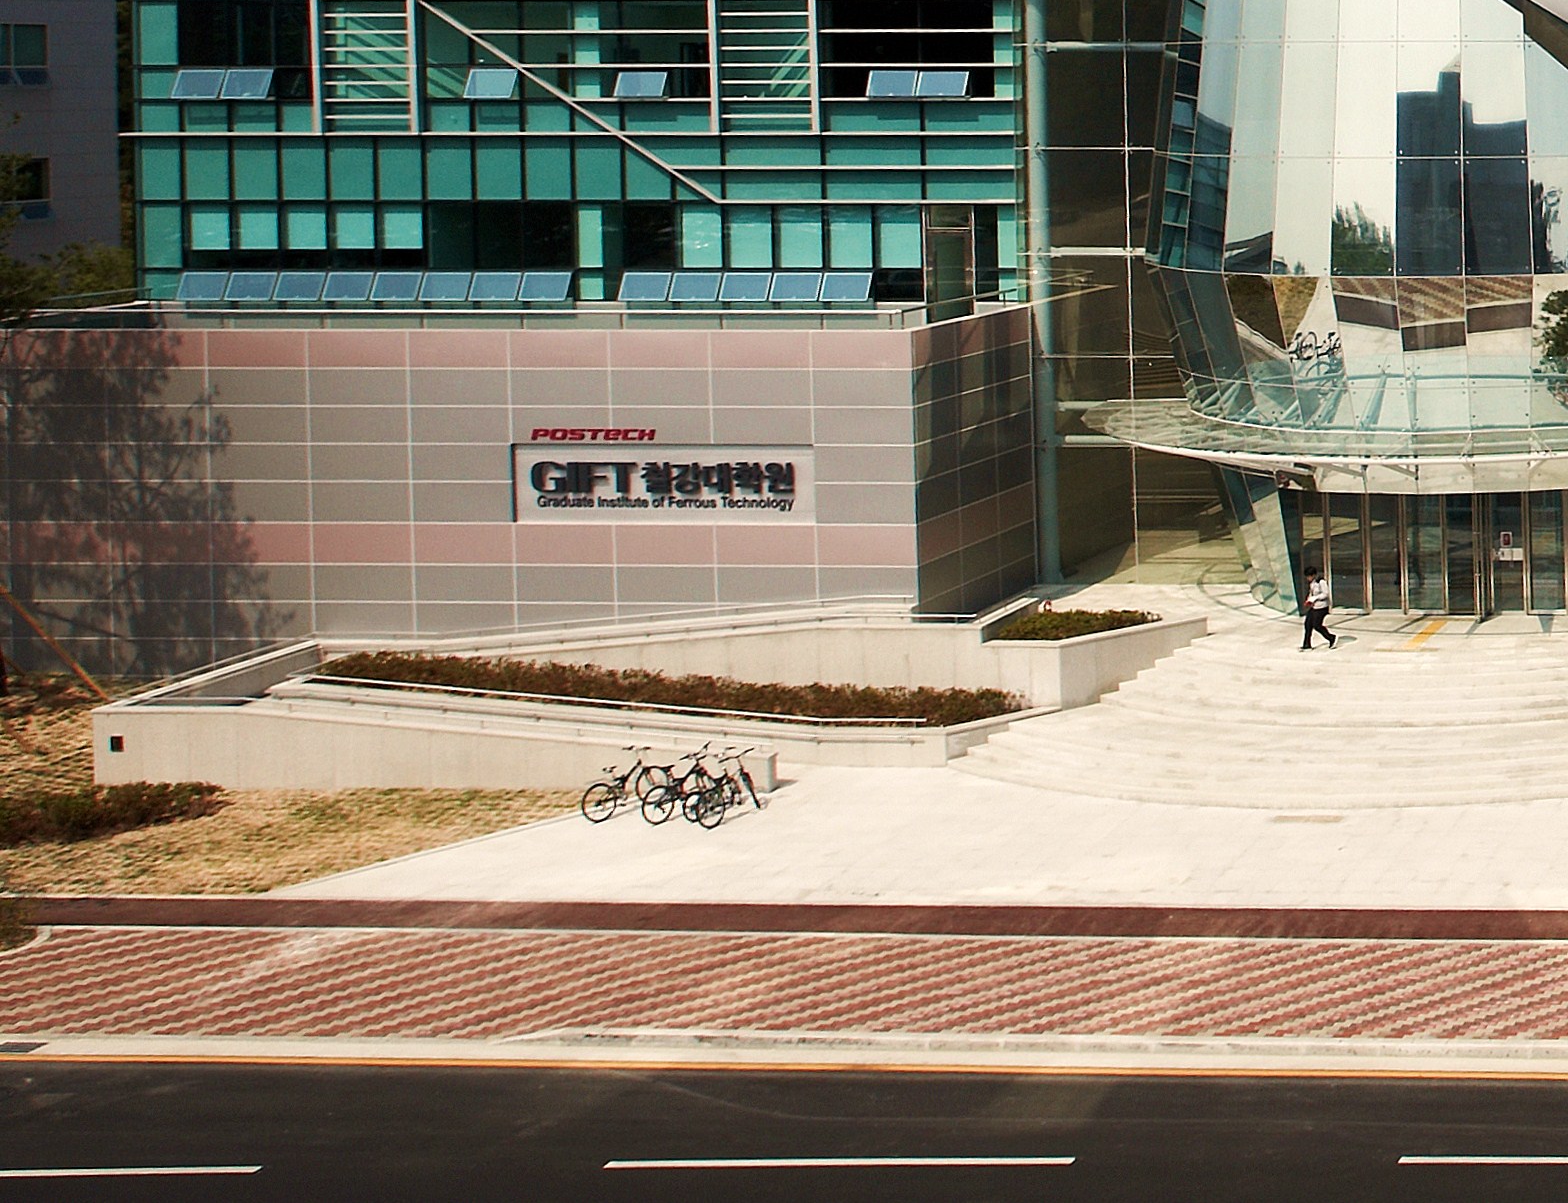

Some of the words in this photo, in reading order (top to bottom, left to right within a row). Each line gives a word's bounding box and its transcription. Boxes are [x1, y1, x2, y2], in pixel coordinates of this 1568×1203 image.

[531, 462, 637, 493] GIFT
[641, 461, 795, 494] 철강대학원
[538, 496, 594, 509] Graduate
[598, 496, 649, 509] Institute
[652, 496, 667, 509] of
[669, 496, 717, 509] Ferrous
[720, 496, 794, 511] Technology
